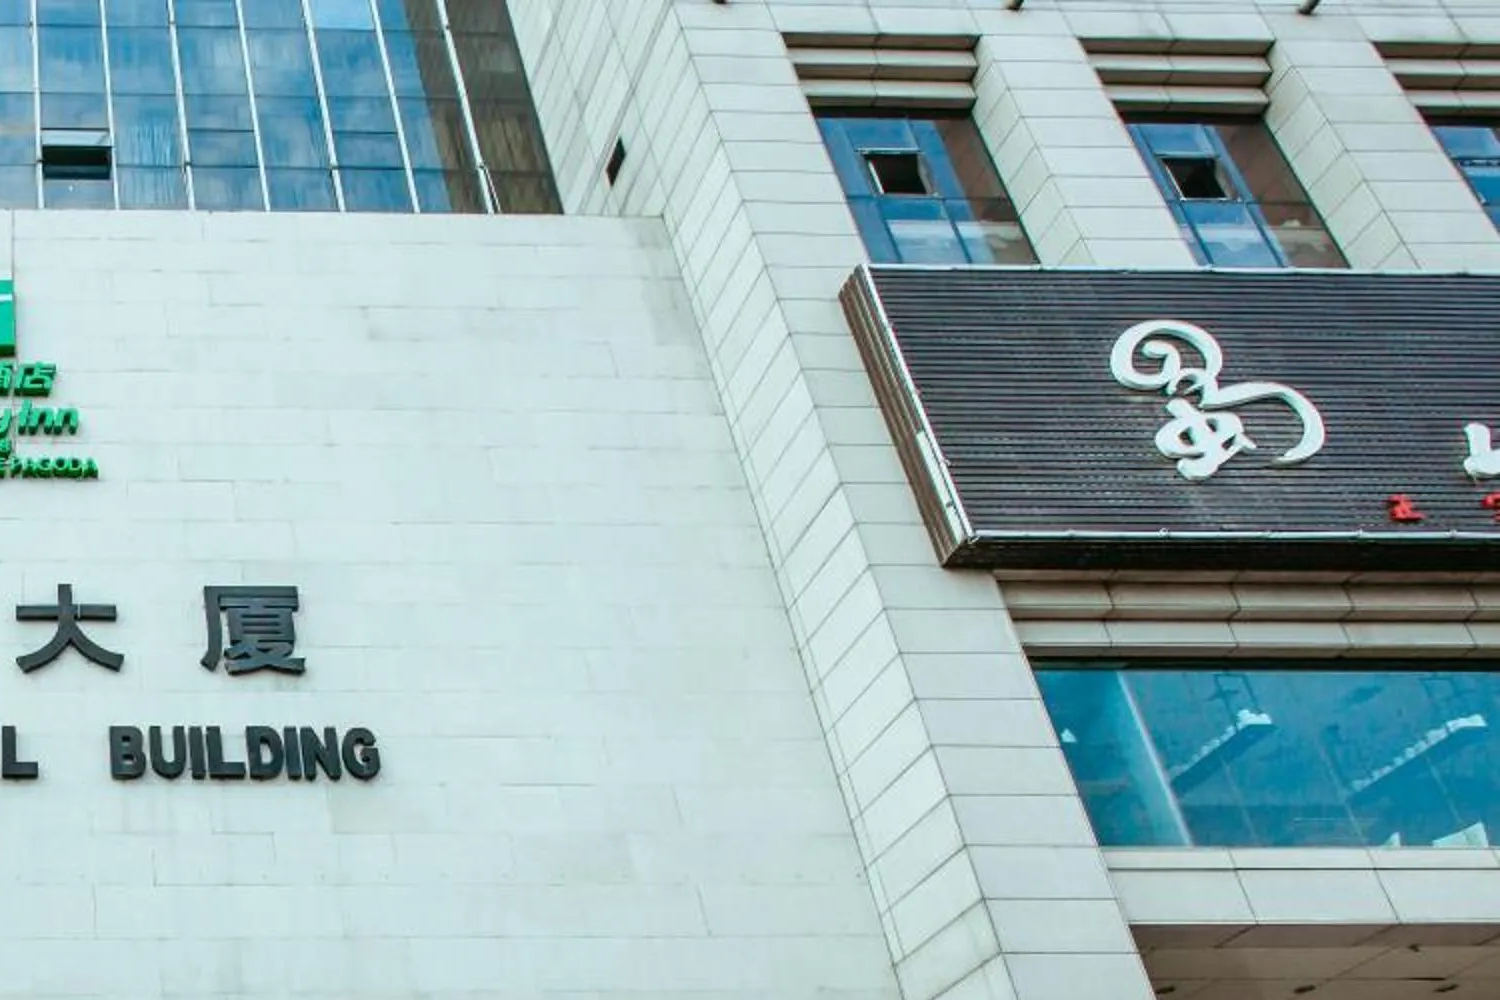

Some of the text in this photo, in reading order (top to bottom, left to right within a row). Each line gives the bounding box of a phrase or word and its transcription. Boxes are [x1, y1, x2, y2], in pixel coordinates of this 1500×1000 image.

[17, 399, 80, 436] Inn
[9, 456, 99, 479] PAGODA
[108, 724, 382, 783] BUILDING
